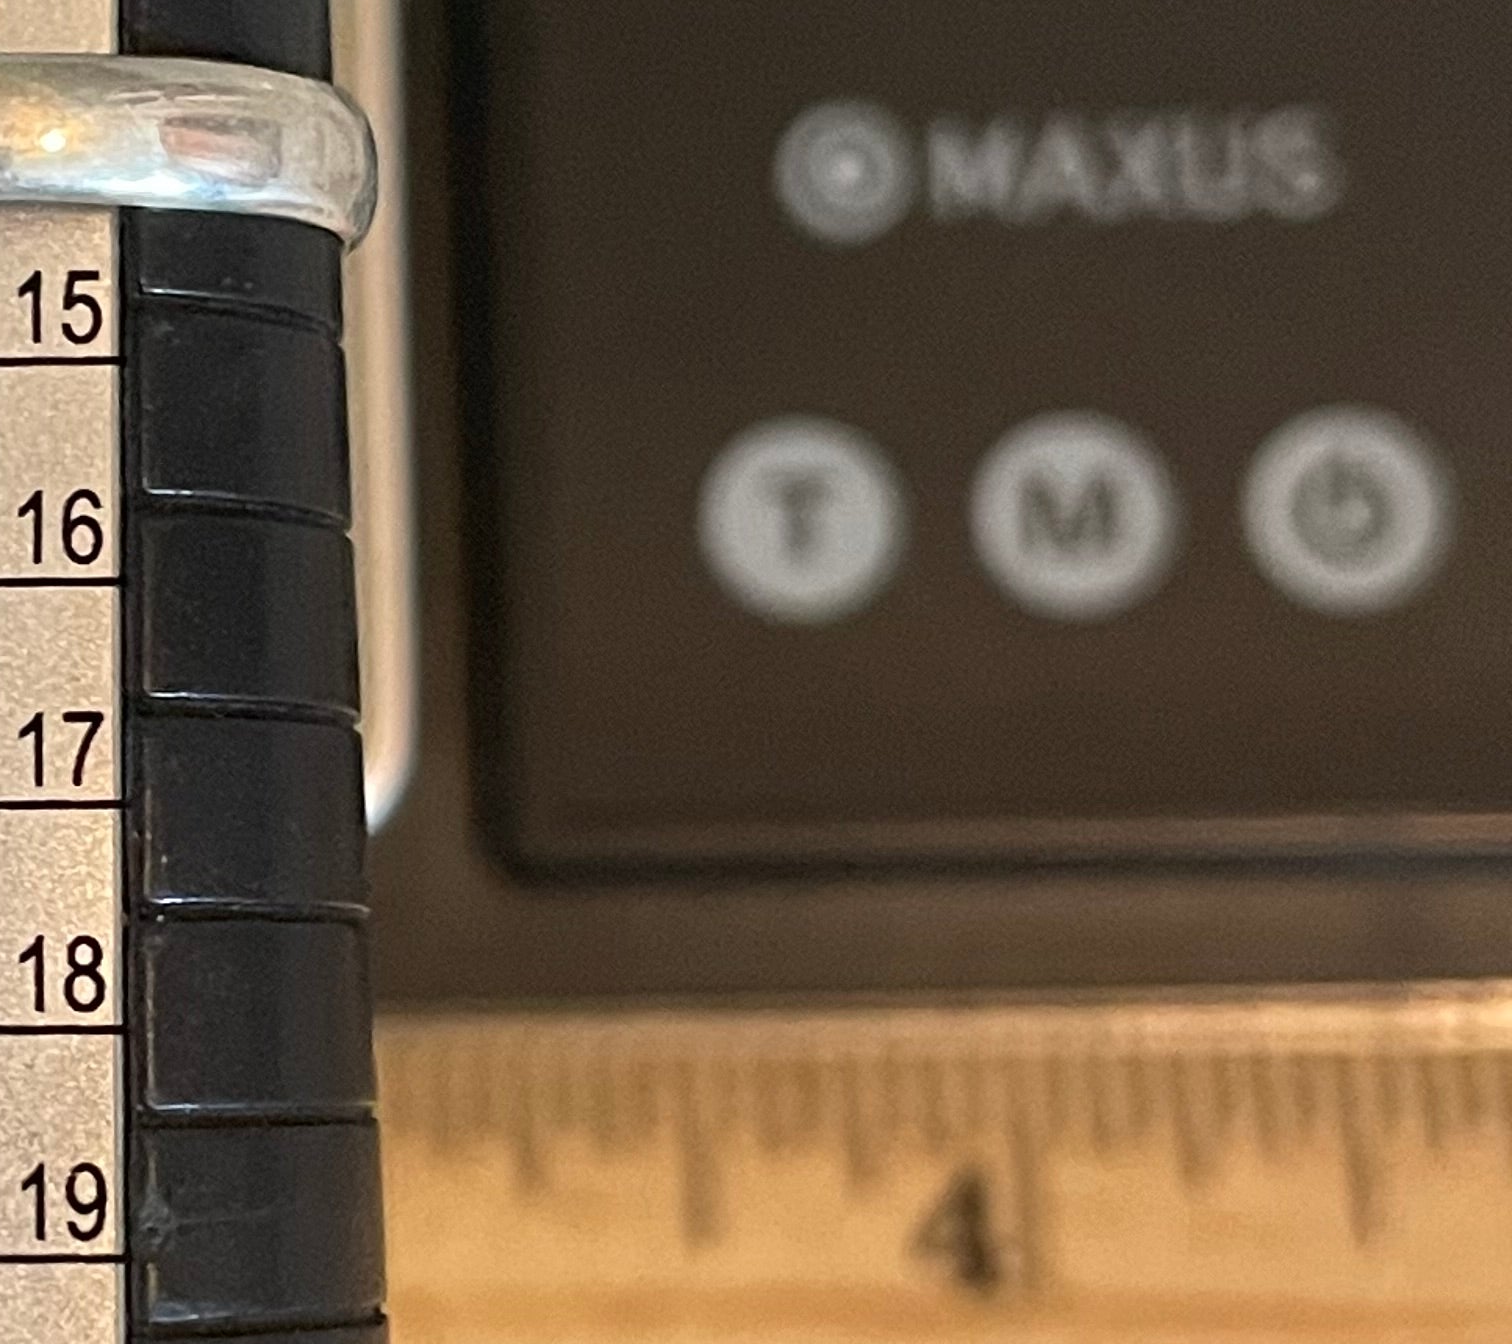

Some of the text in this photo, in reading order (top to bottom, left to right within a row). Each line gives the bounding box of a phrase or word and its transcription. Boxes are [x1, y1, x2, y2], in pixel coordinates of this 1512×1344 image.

[923, 101, 1343, 226] MAXUS
[17, 270, 104, 345] 15
[16, 488, 105, 566] 16
[756, 468, 836, 570] T
[1016, 474, 1120, 561] M
[17, 710, 105, 787] 17
[18, 934, 107, 1013] 18
[20, 1162, 109, 1242] 19
[903, 1161, 1003, 1301] 4
